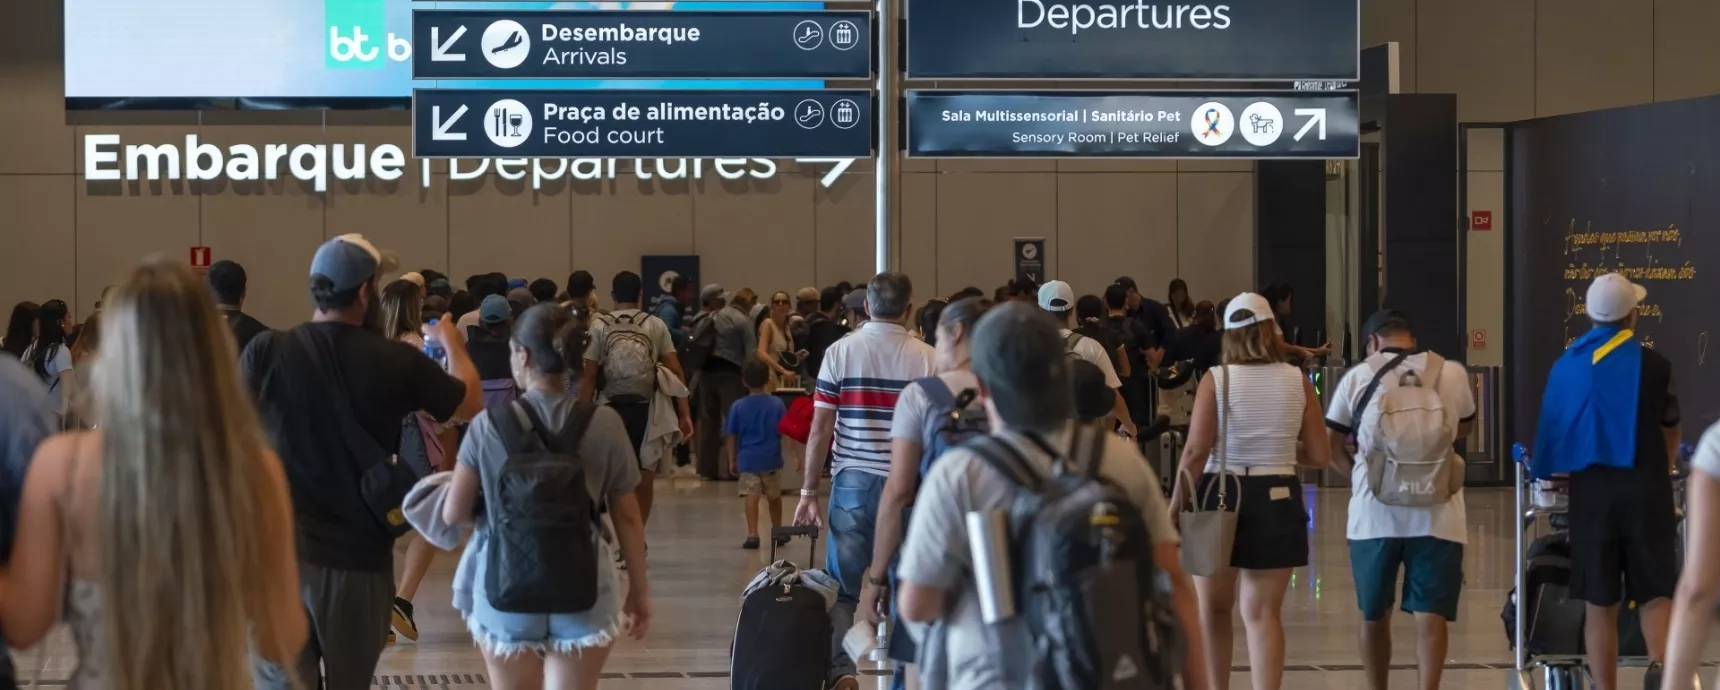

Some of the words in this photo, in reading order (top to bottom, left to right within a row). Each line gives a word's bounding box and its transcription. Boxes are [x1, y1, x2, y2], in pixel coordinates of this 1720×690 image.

[1017, 0, 1231, 35] Departures
[542, 23, 701, 44] Desembarque
[330, 25, 380, 62] bt
[543, 47, 627, 65] Arrivals
[544, 103, 606, 123] Praça
[613, 102, 641, 121] de
[647, 102, 785, 123] alimentação
[942, 110, 970, 121] Sala
[976, 110, 1078, 122] Multissensorial
[1091, 109, 1154, 122] Sanitário
[1158, 110, 1181, 122] Pet
[544, 126, 600, 144] Food
[607, 126, 665, 144] court
[1012, 132, 1064, 145] Sensory
[1068, 132, 1106, 143] Room
[1118, 132, 1139, 143] Pet
[1143, 132, 1180, 143] Relief
[84, 134, 406, 192] Embarque
[1398, 481, 1436, 495] FILA
